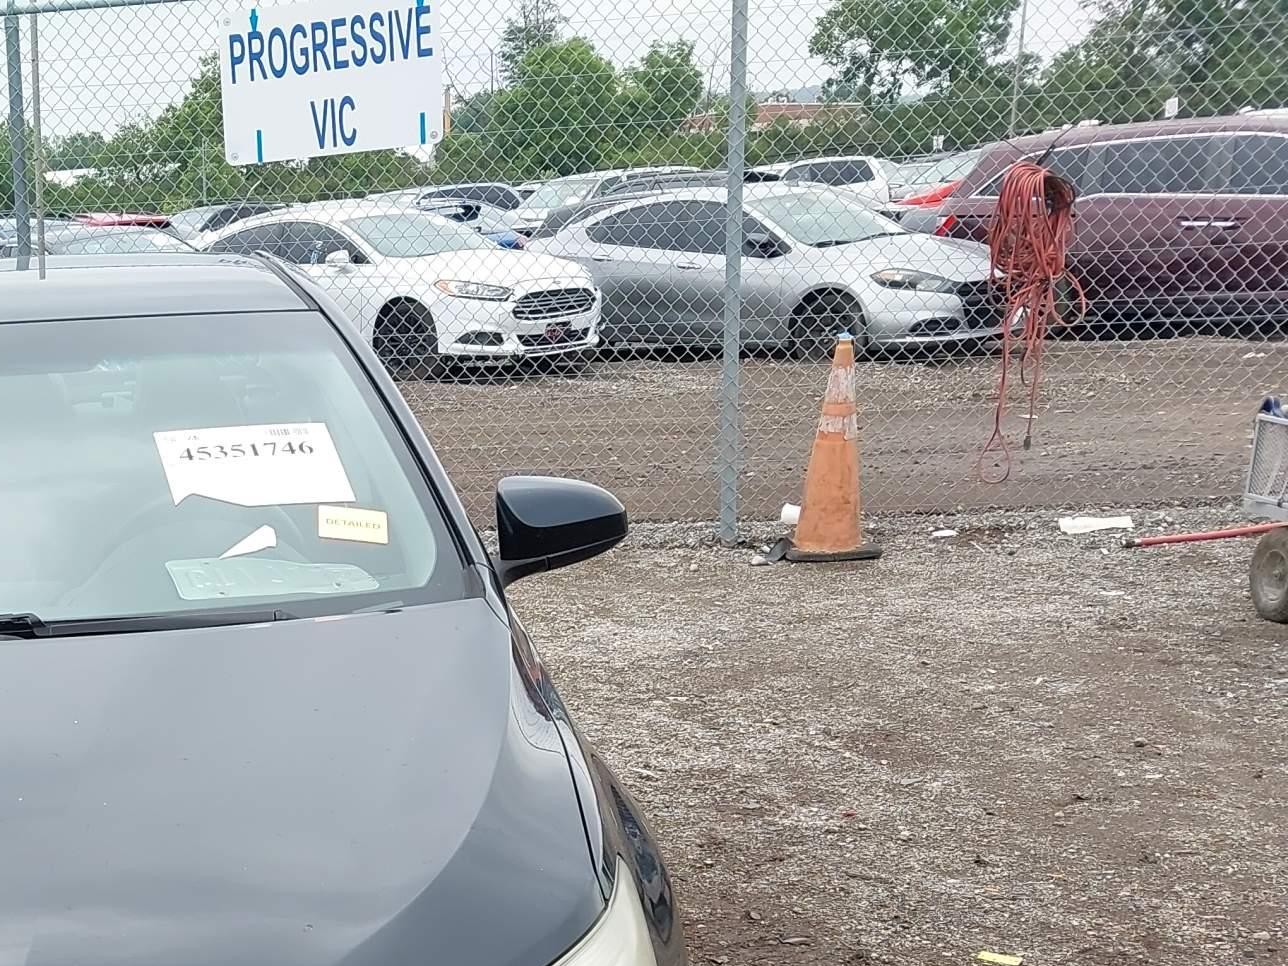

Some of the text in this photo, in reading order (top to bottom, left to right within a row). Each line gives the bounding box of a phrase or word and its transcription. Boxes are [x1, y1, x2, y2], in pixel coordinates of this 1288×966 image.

[228, 5, 433, 84] PROGRESSIVE
[310, 95, 357, 149] VIC
[179, 440, 315, 461] 45351746
[326, 518, 381, 530] DETAILED
